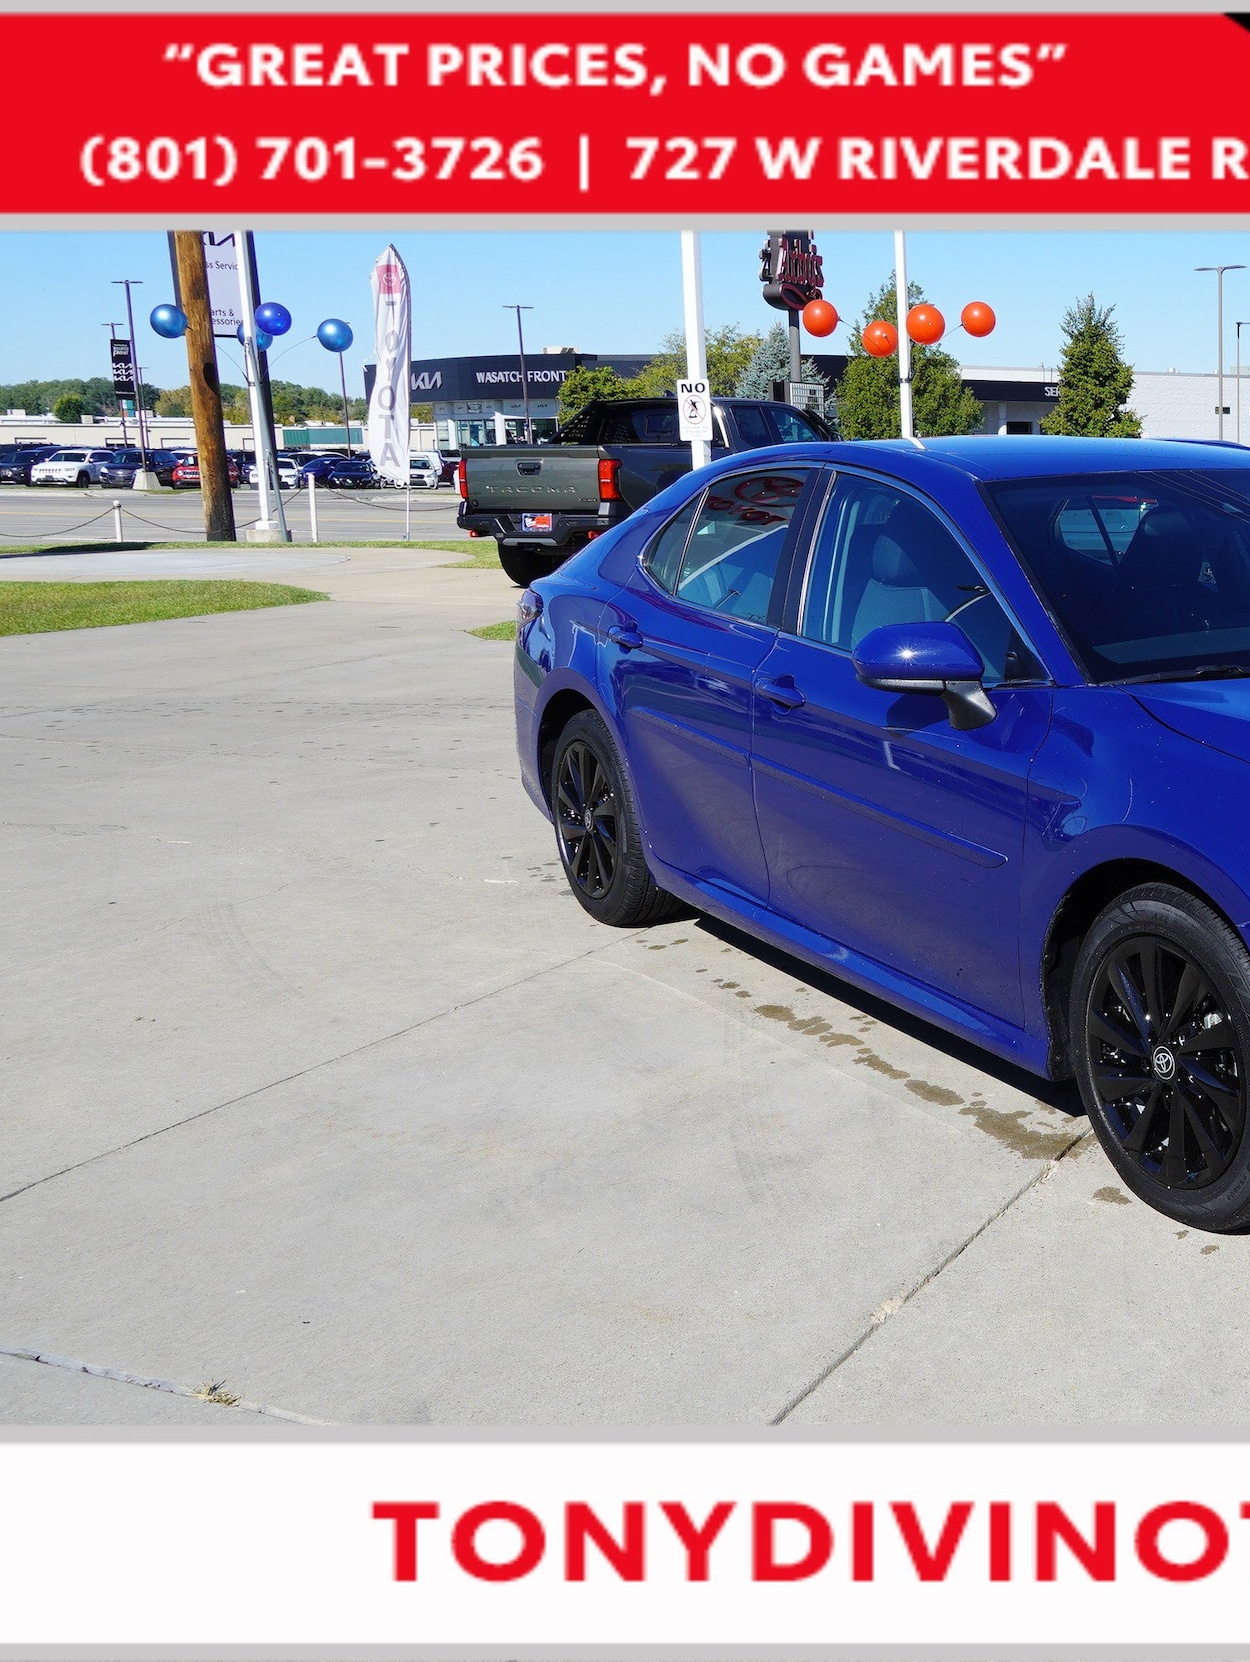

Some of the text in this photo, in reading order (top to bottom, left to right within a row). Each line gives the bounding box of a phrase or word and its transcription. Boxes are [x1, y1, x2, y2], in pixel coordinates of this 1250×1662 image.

[475, 371, 566, 383] WASATCH FRONT
[378, 301, 400, 467] TOYOTA
[681, 382, 706, 393] NO
[1044, 386, 1060, 397] SER
[485, 485, 576, 493] TACOMA
